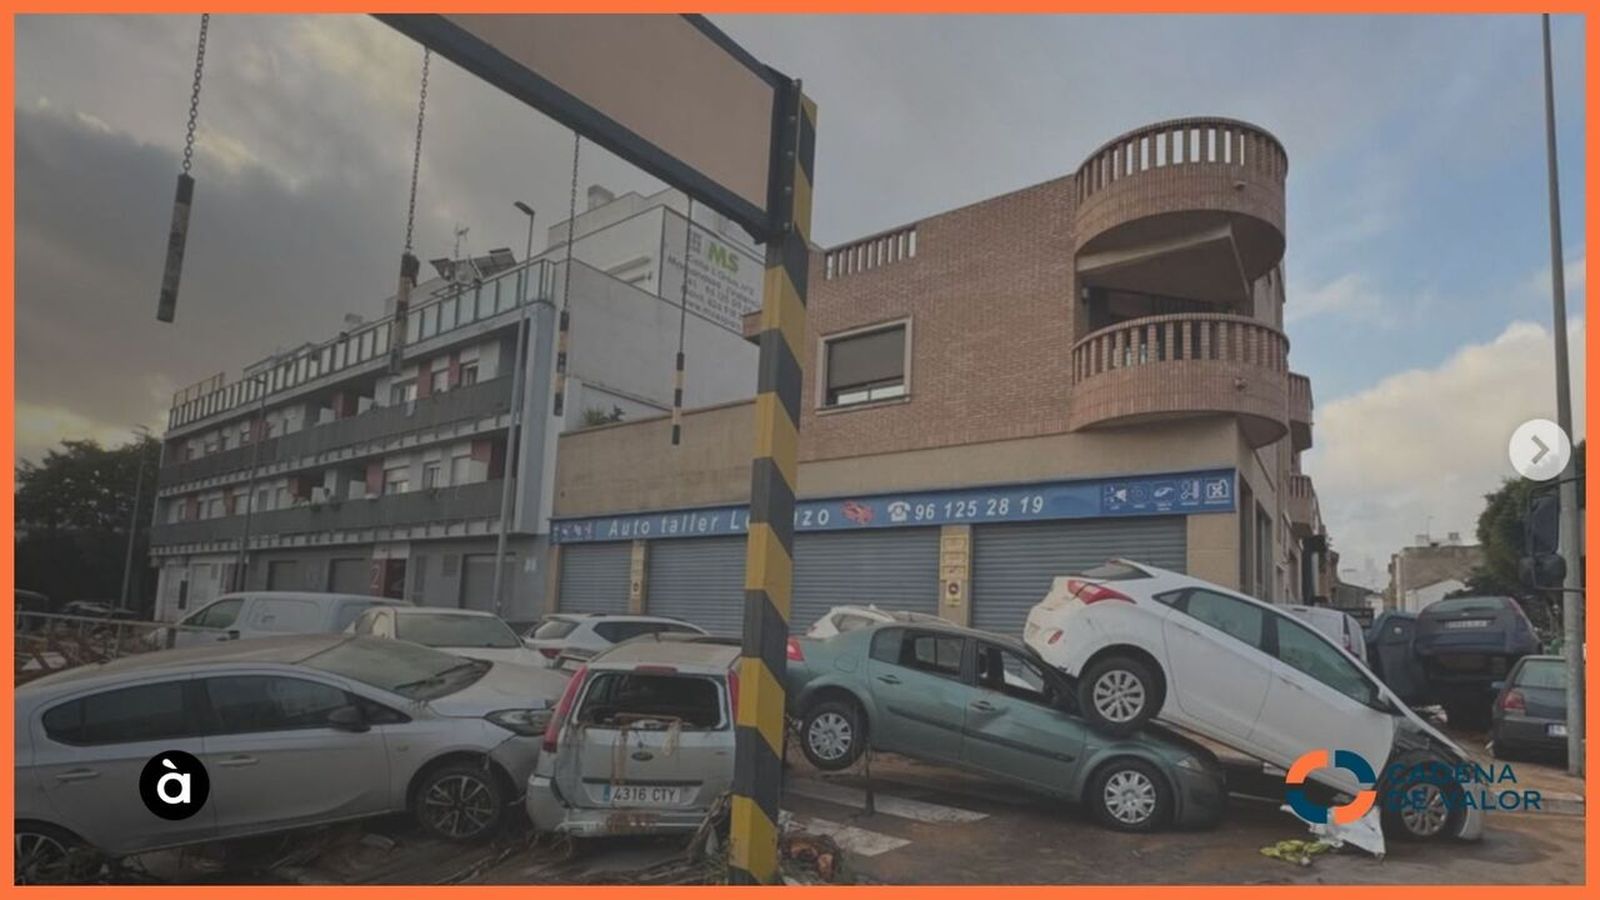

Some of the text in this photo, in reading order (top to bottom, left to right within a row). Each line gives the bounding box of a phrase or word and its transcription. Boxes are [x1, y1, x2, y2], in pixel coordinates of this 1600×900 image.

[914, 496, 1044, 521] 96 125 28 19
[608, 519, 651, 538] Auto
[660, 511, 719, 533] taller
[613, 787, 677, 801] 4316 CTY
